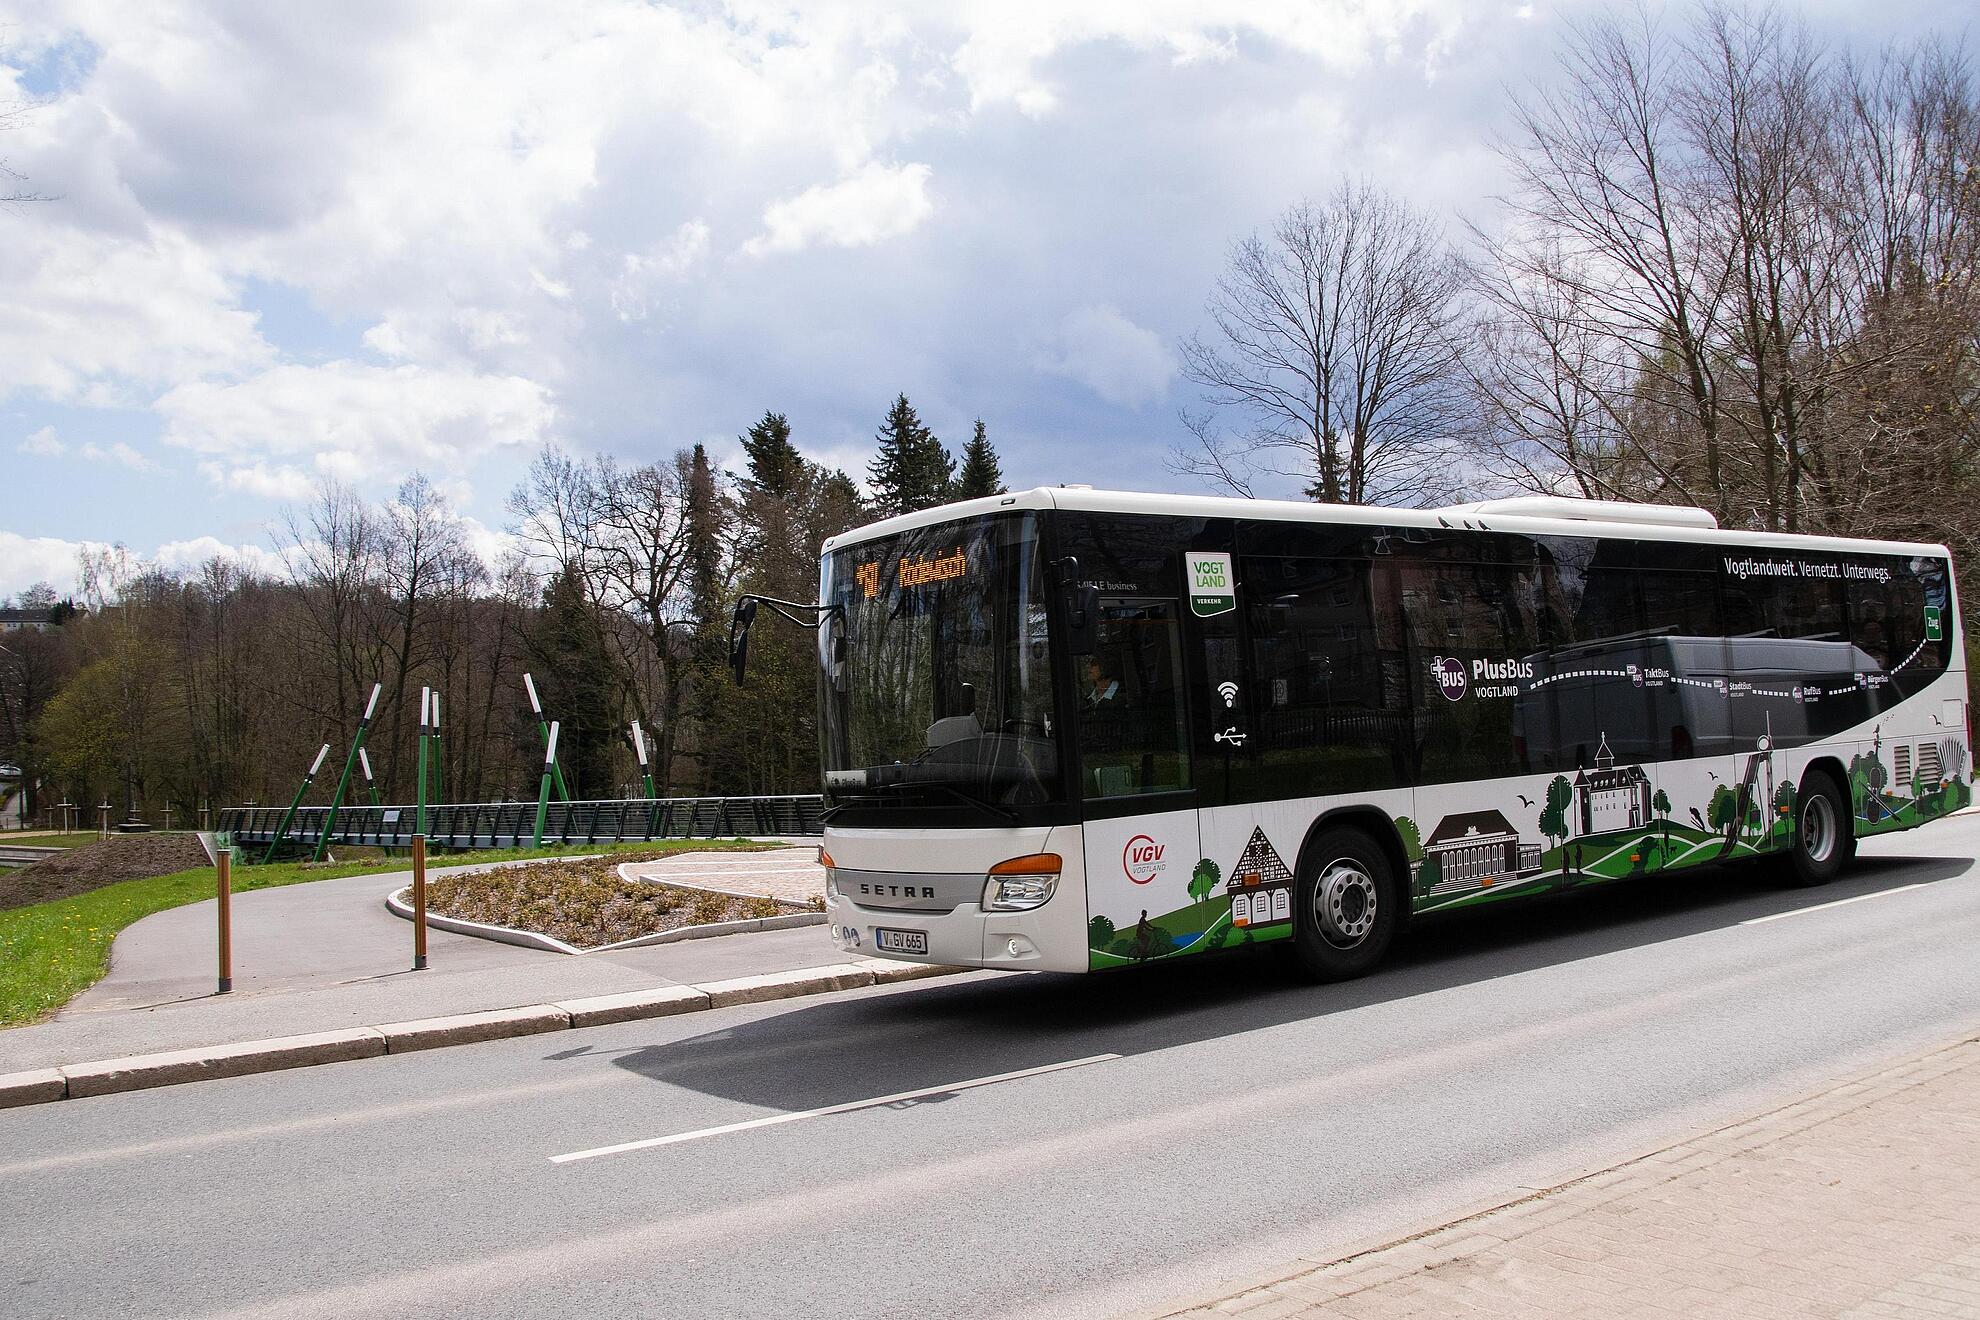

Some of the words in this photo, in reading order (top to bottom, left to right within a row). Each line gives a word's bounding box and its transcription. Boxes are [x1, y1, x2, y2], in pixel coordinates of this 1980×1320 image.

[899, 546, 966, 588] Rodewisch
[1193, 561, 1225, 574] VOGT
[1724, 557, 1798, 580] Vogtlandweit.
[1798, 560, 1842, 579] Vernetzt.
[1842, 562, 1892, 583] Unterwegs.
[1106, 580, 1138, 591] business
[1196, 575, 1226, 588] LAND
[1472, 658, 1533, 680] PlusBus
[1644, 668, 1670, 678] TaktBus
[1475, 685, 1519, 698] VOGTLAND
[1729, 681, 1752, 691] StadtBus
[1132, 844, 1166, 863] VGV
[1132, 863, 1166, 874] VOGTLAND
[860, 883, 935, 899] SETRA
[883, 932, 889, 946] V
[893, 933, 904, 949] GV
[906, 934, 922, 949] 665
